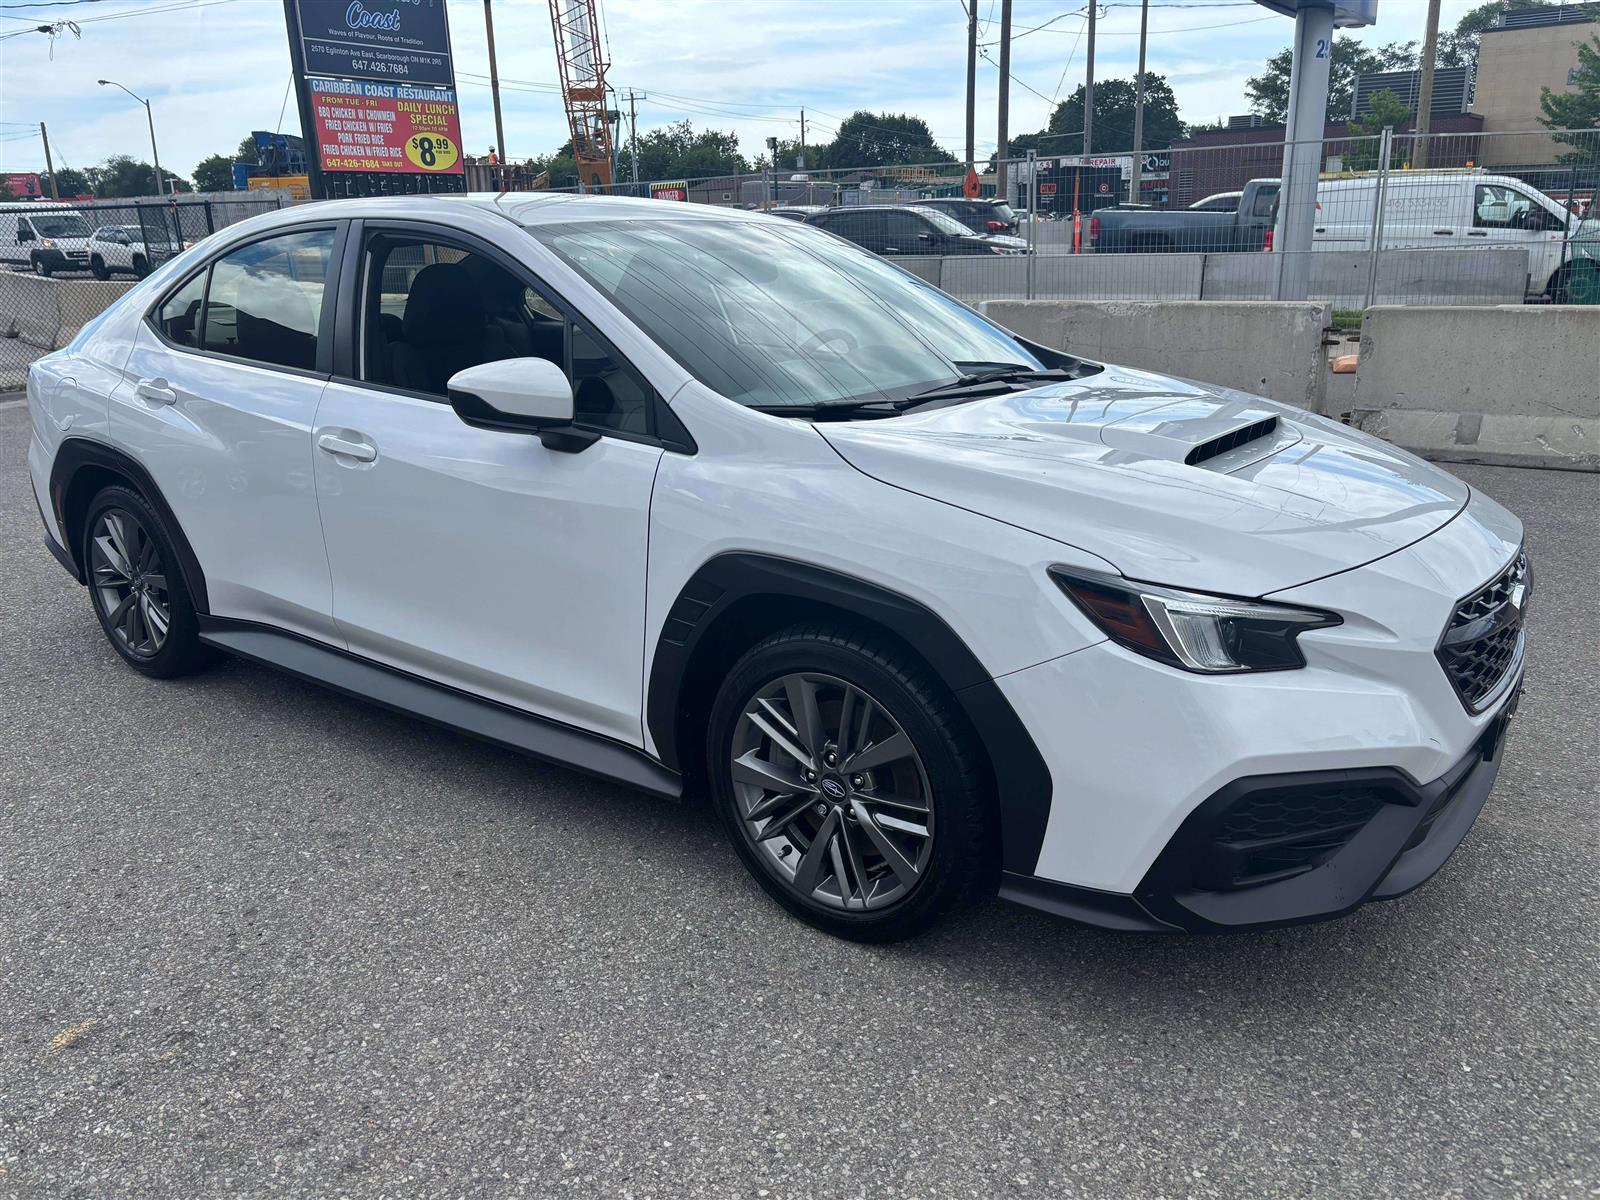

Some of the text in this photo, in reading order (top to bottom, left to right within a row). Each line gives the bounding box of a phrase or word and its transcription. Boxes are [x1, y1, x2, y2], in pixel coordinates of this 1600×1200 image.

[346, 0, 400, 31] Coast
[328, 28, 346, 37] Waves
[355, 31, 376, 40] Flavour,
[378, 34, 393, 42] Roots
[401, 37, 423, 46] Tradition
[311, 45, 324, 53] 2570
[326, 46, 349, 56] Eglinton
[350, 49, 360, 57] Ave
[362, 50, 375, 59] East,
[376, 52, 409, 63] Scarborough
[352, 60, 408, 74] 647.426.7684
[312, 80, 453, 102] CARIBBEAN COAST RESTAURANT
[322, 96, 342, 104] FROM
[346, 98, 360, 106] TUE
[366, 99, 378, 107] FRI
[397, 101, 455, 115] DAILY LUNCH
[318, 106, 331, 118] BBQ
[331, 107, 356, 119] CHICKEN
[366, 110, 396, 121] CHOWMEIN
[410, 113, 448, 126] SPECIAL
[325, 119, 342, 131] FRIED
[343, 121, 367, 132] CHICKEN
[377, 123, 393, 133] FRIES
[337, 132, 385, 145] PORK FRIED RICE
[322, 144, 340, 155] FRIED
[340, 145, 365, 156] CHICKEN
[389, 147, 403, 158] RICE
[326, 158, 380, 168] 647-426-7684
[658, 190, 679, 200] DANGER
